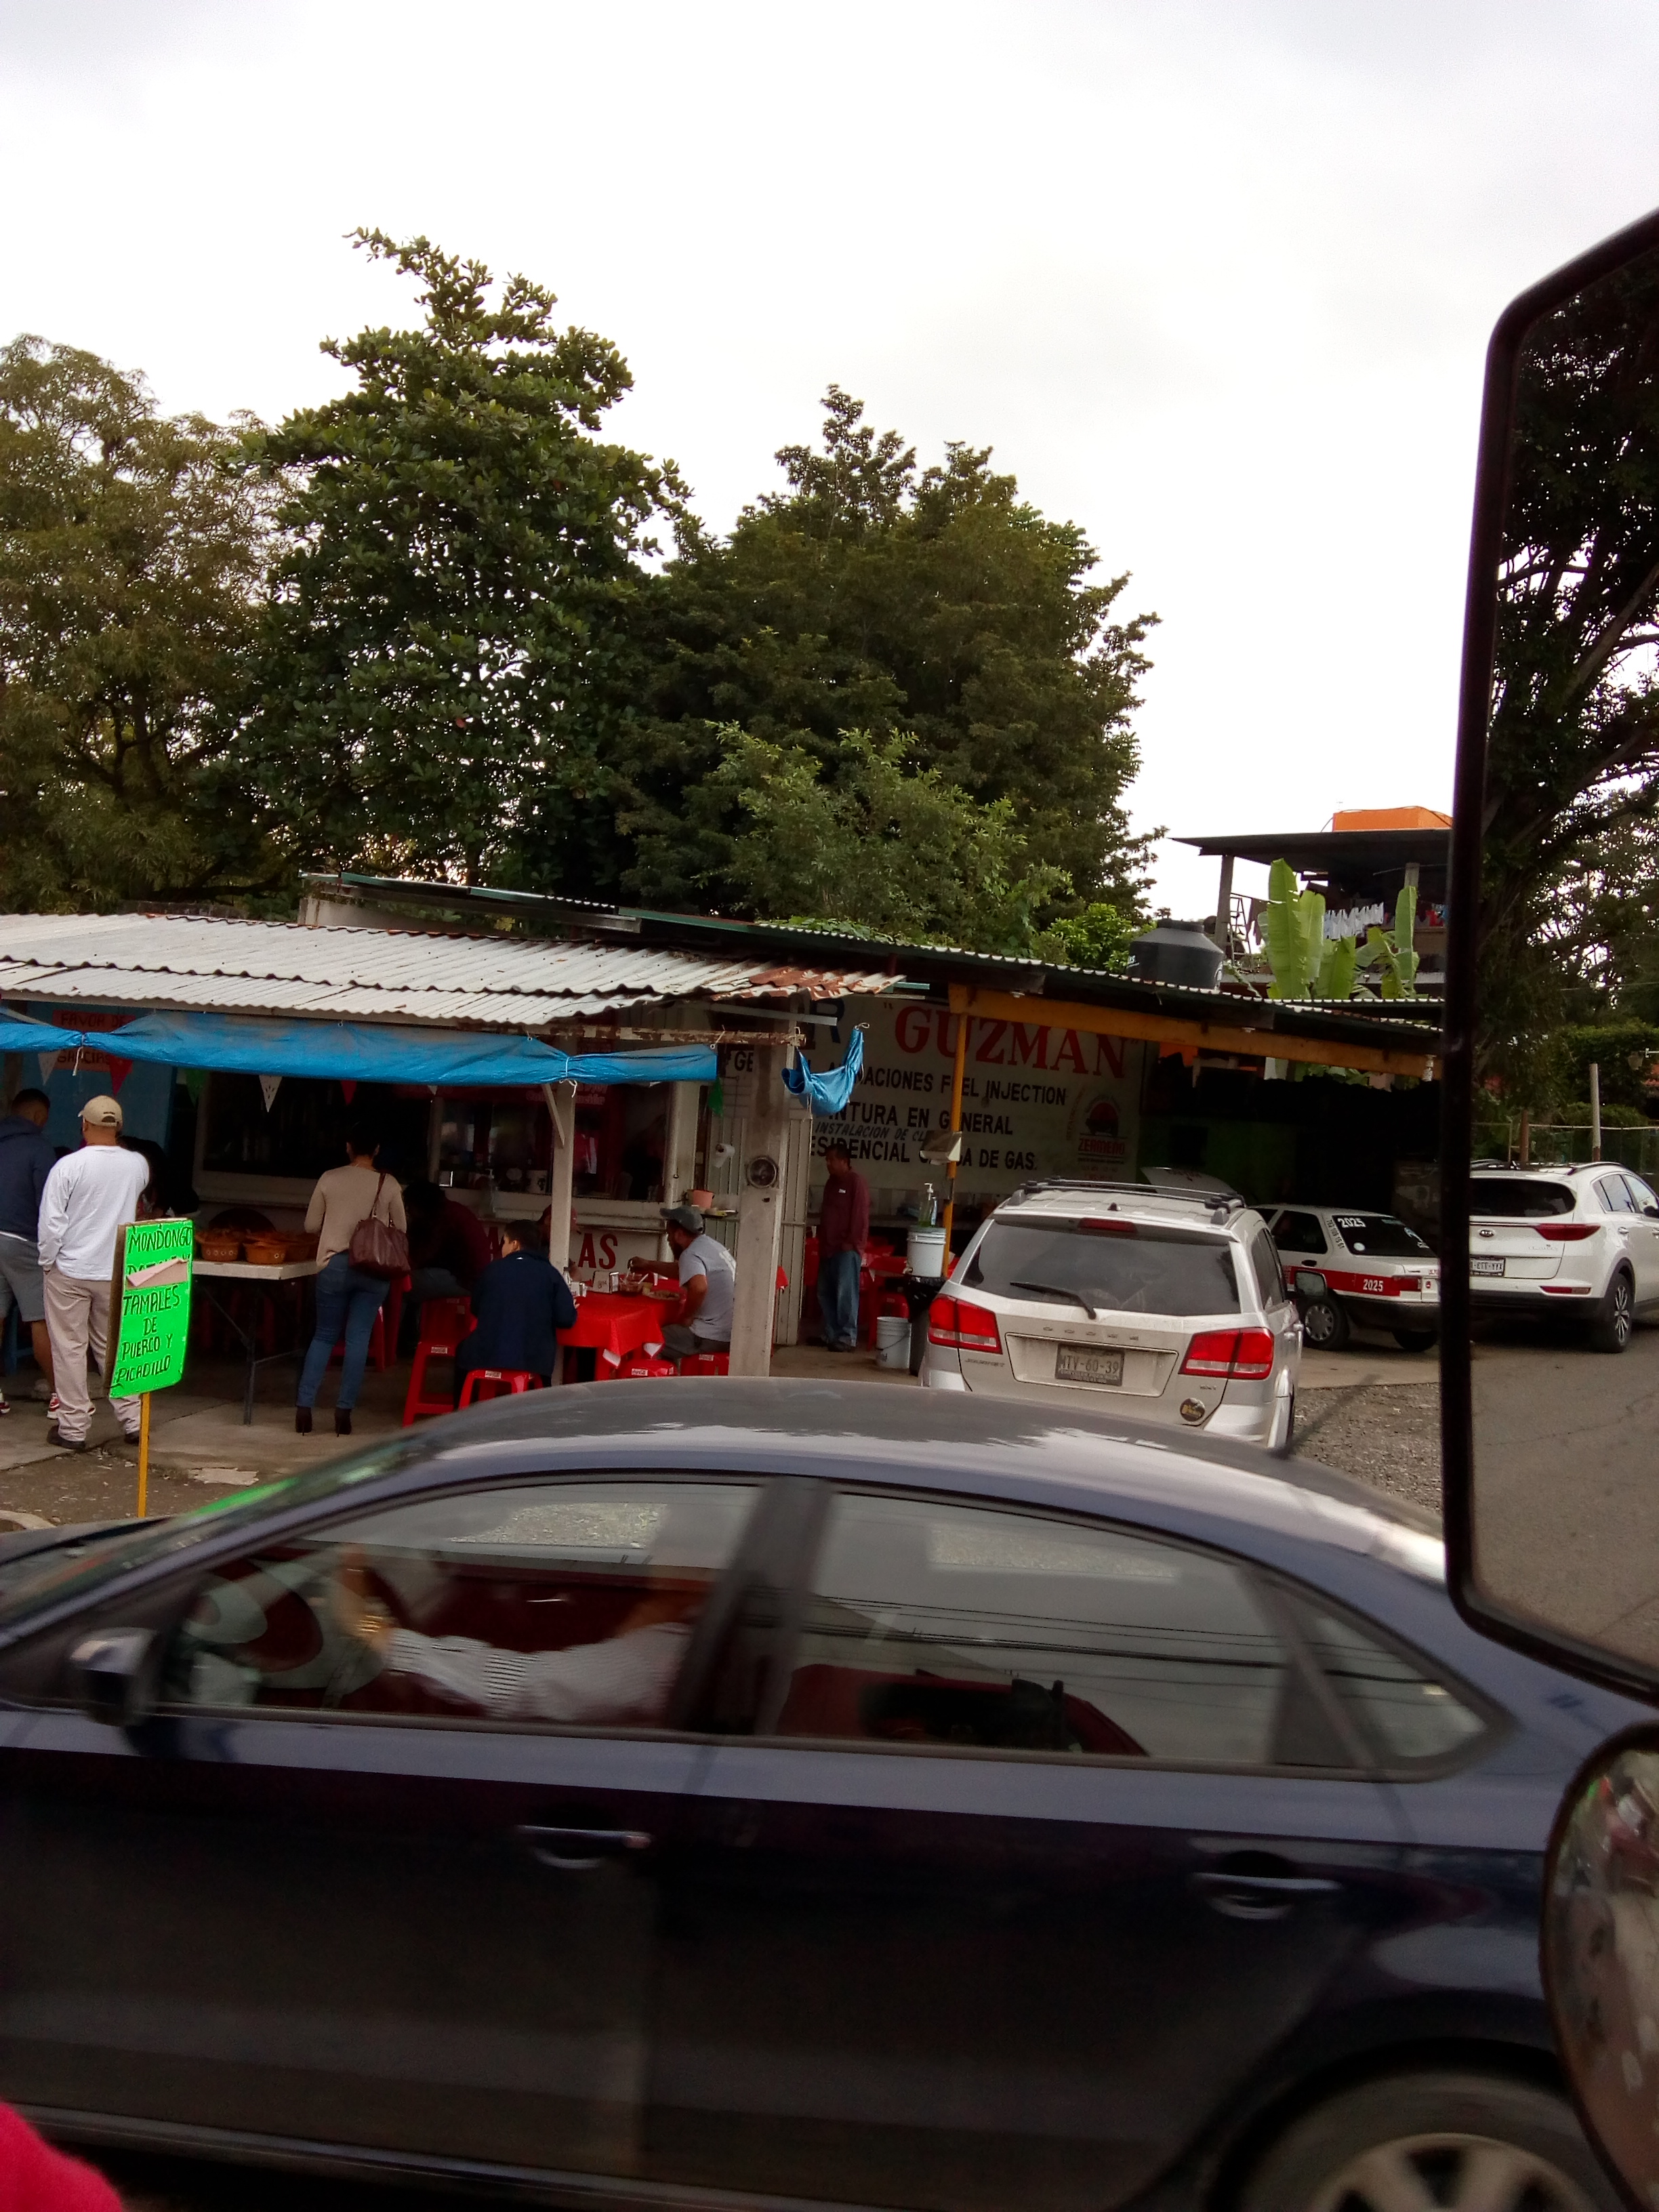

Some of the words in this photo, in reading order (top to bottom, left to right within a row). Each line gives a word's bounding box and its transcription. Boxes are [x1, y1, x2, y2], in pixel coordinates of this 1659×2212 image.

[60, 1013, 104, 1027] FAVOR
[941, 1075, 979, 1097] FEL
[985, 1080, 1067, 1106] INJECTION
[829, 1101, 898, 1126] NTURA
[907, 1107, 930, 1128] EN
[939, 1110, 1013, 1135] GNERAL
[815, 1122, 890, 1139] INSTALACION
[894, 1128, 909, 1141] DE
[979, 1149, 1000, 1168] DE
[1337, 1217, 1367, 1229] 2025
[128, 1226, 192, 1254] MONDONGO
[1362, 1278, 1385, 1292] 2025
[123, 1285, 180, 1316] TAMALES
[143, 1317, 157, 1336] DE
[121, 1336, 160, 1361] PUERCO
[165, 1333, 173, 1349] Y
[117, 1355, 171, 1383] PICADILLO
